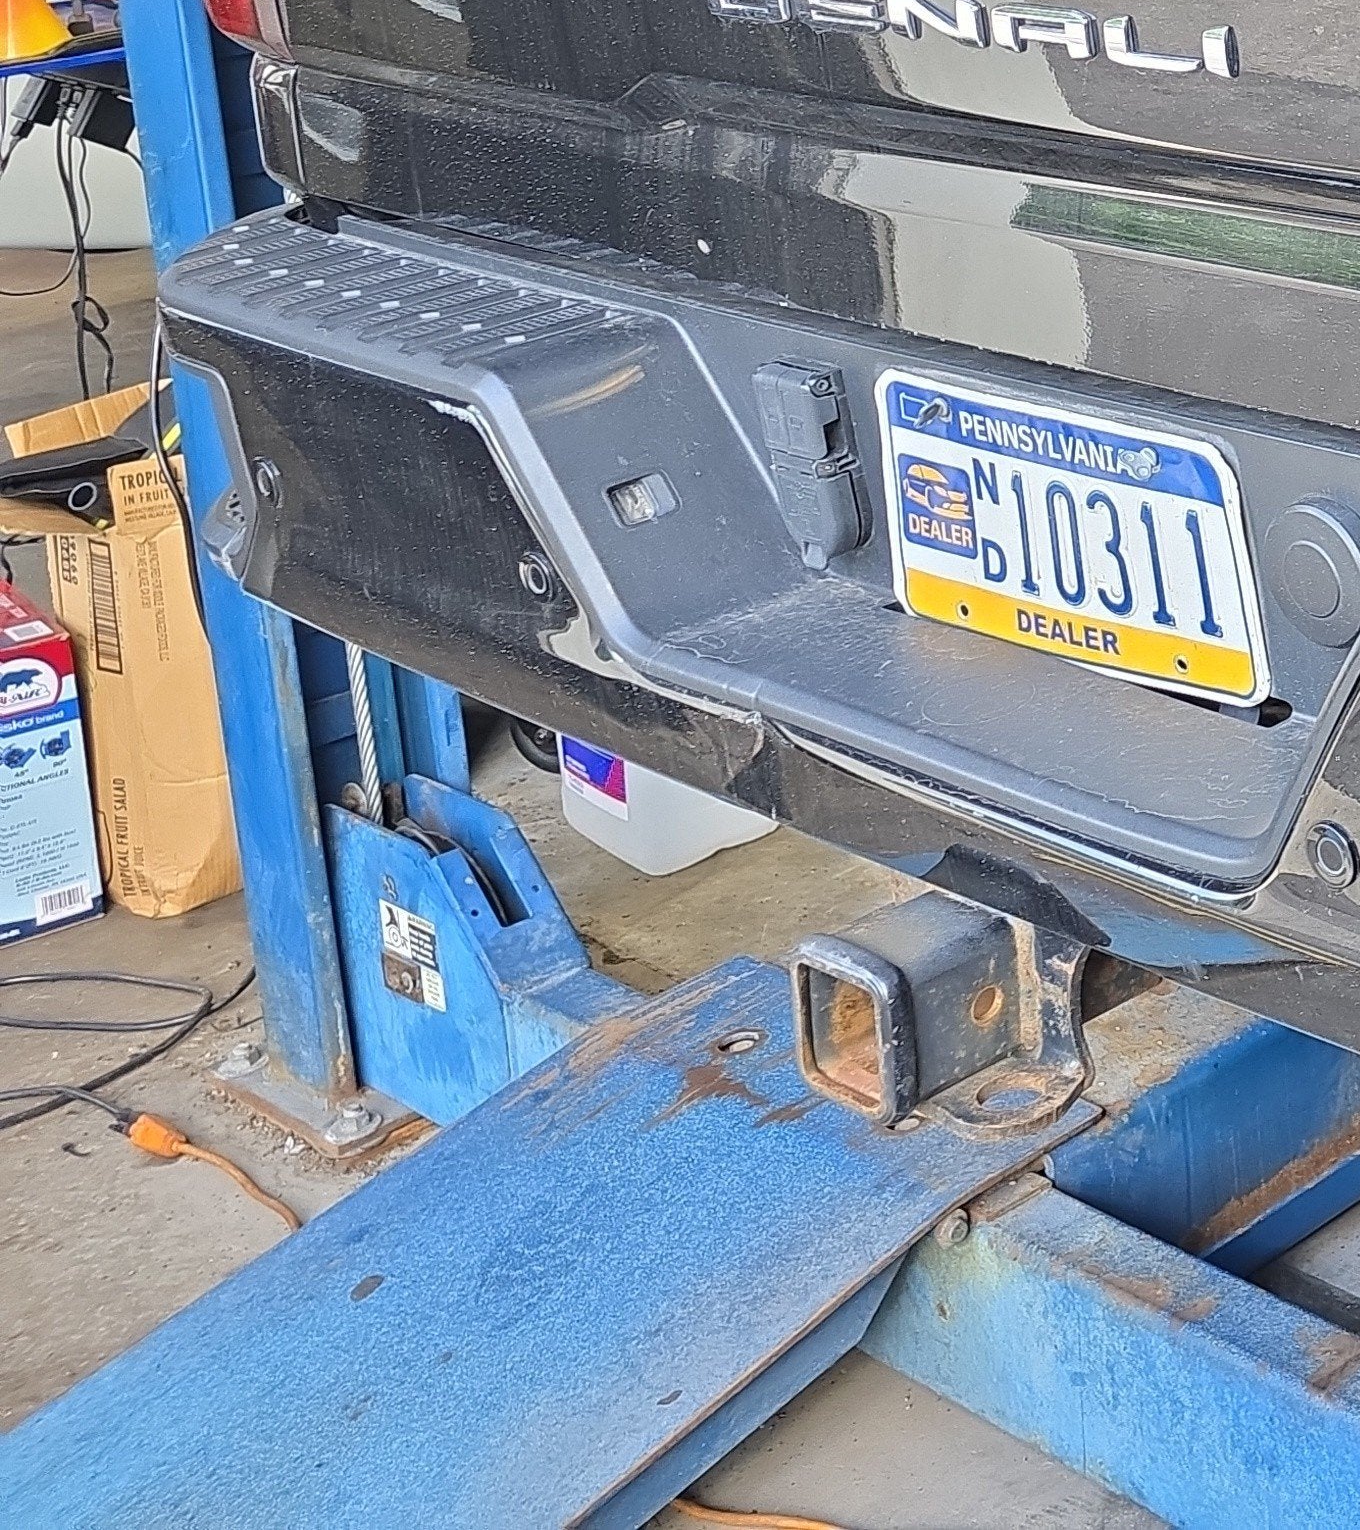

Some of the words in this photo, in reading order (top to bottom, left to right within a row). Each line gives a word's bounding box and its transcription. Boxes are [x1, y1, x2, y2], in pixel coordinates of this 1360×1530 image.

[119, 467, 183, 491] TROPICL
[123, 494, 136, 506] IN
[139, 488, 170, 504] FRUIT
[908, 513, 974, 549] DEALER
[1011, 470, 1224, 638] 10311
[1016, 608, 1121, 656] DEALER
[35, 709, 65, 727] brand
[112, 778, 129, 811] SALAD
[114, 816, 130, 846] FRUIT
[117, 849, 138, 898] TROPICAL
